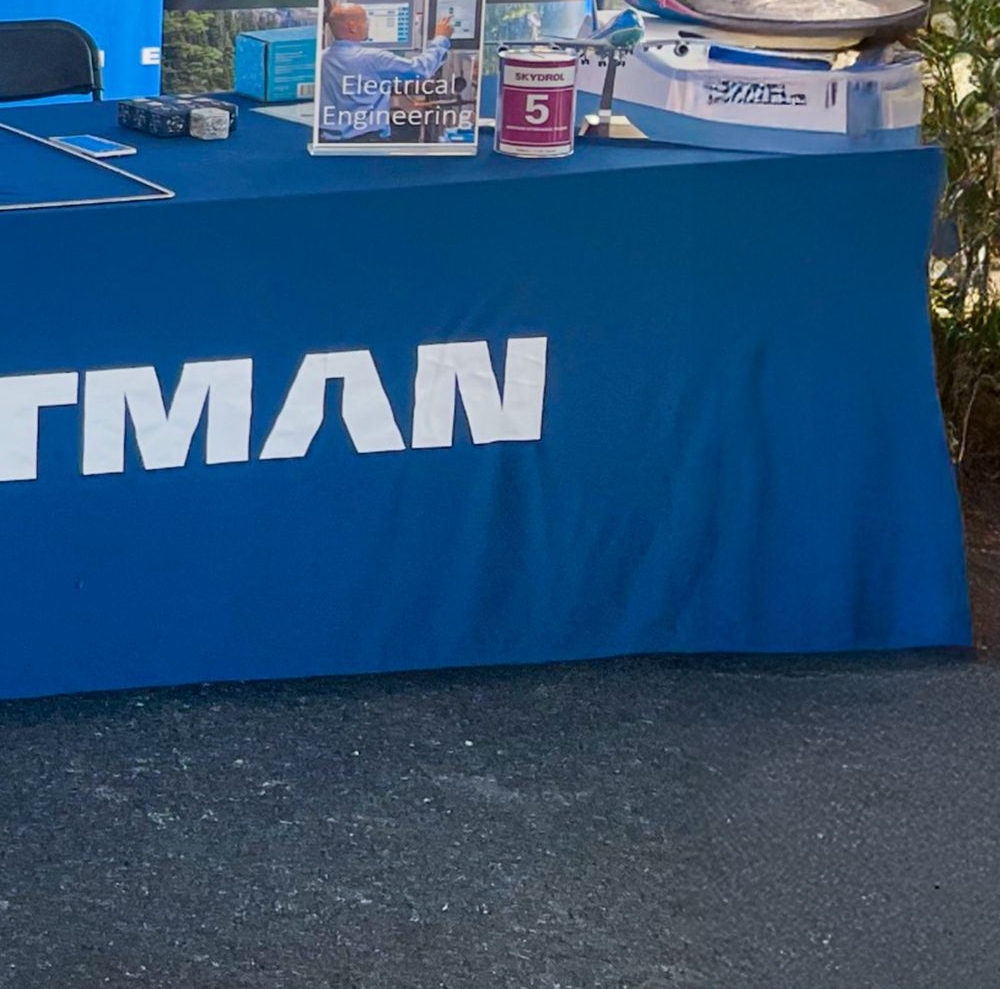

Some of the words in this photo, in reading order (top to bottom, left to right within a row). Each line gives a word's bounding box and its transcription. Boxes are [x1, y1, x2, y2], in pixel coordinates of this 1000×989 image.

[341, 74, 457, 95] Electrical
[515, 72, 565, 82] SKYDROL
[322, 105, 473, 130] Engineering
[524, 94, 550, 125] 5
